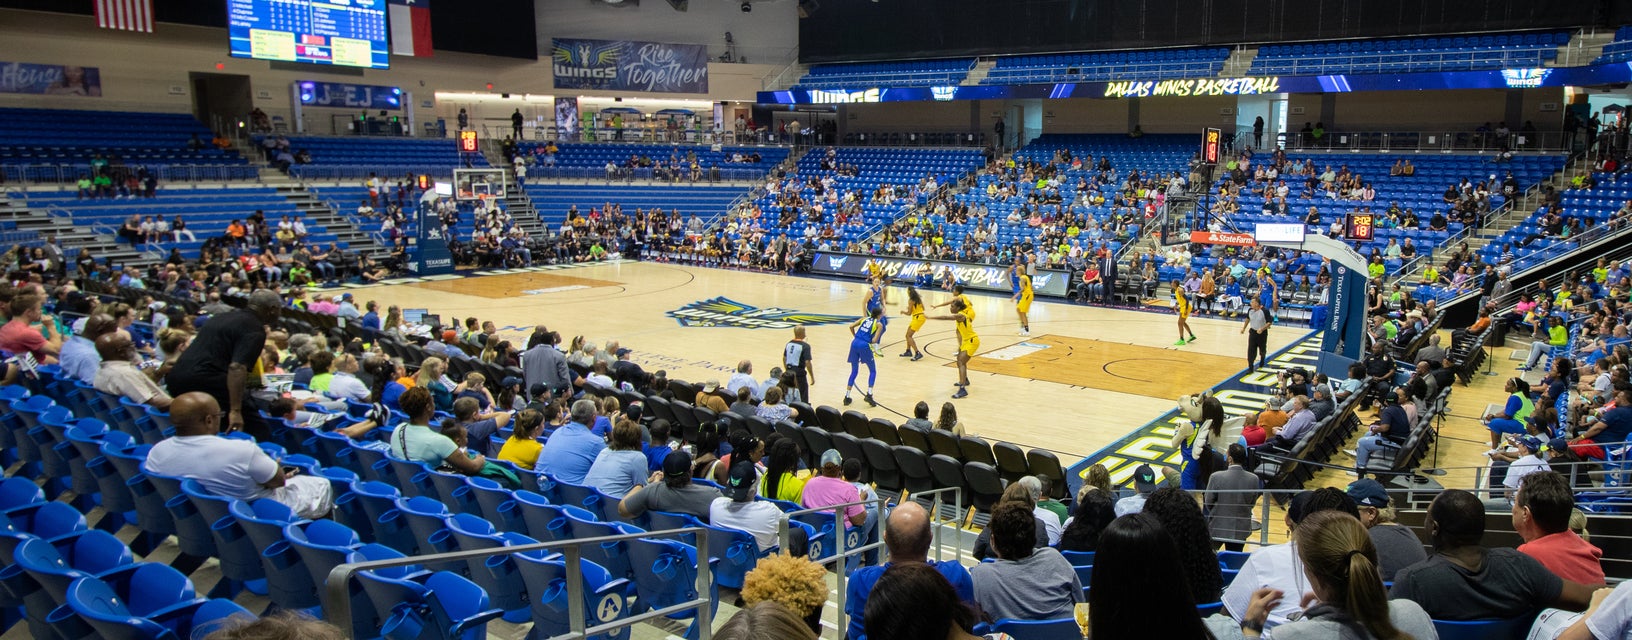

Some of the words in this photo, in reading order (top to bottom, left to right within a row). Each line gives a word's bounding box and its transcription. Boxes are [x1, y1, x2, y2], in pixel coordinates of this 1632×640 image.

[638, 43, 675, 65] Rise
[624, 59, 707, 92] Together
[1104, 81, 1152, 97] DALLAS
[1153, 80, 1194, 97] WINGS
[1193, 77, 1279, 96] BASKETBALL
[464, 139, 475, 150] 18
[1353, 216, 1371, 226] 2:02
[1285, 226, 1301, 234] LIFE
[1356, 225, 1367, 237] 18
[1336, 275, 1344, 293] TEXAS
